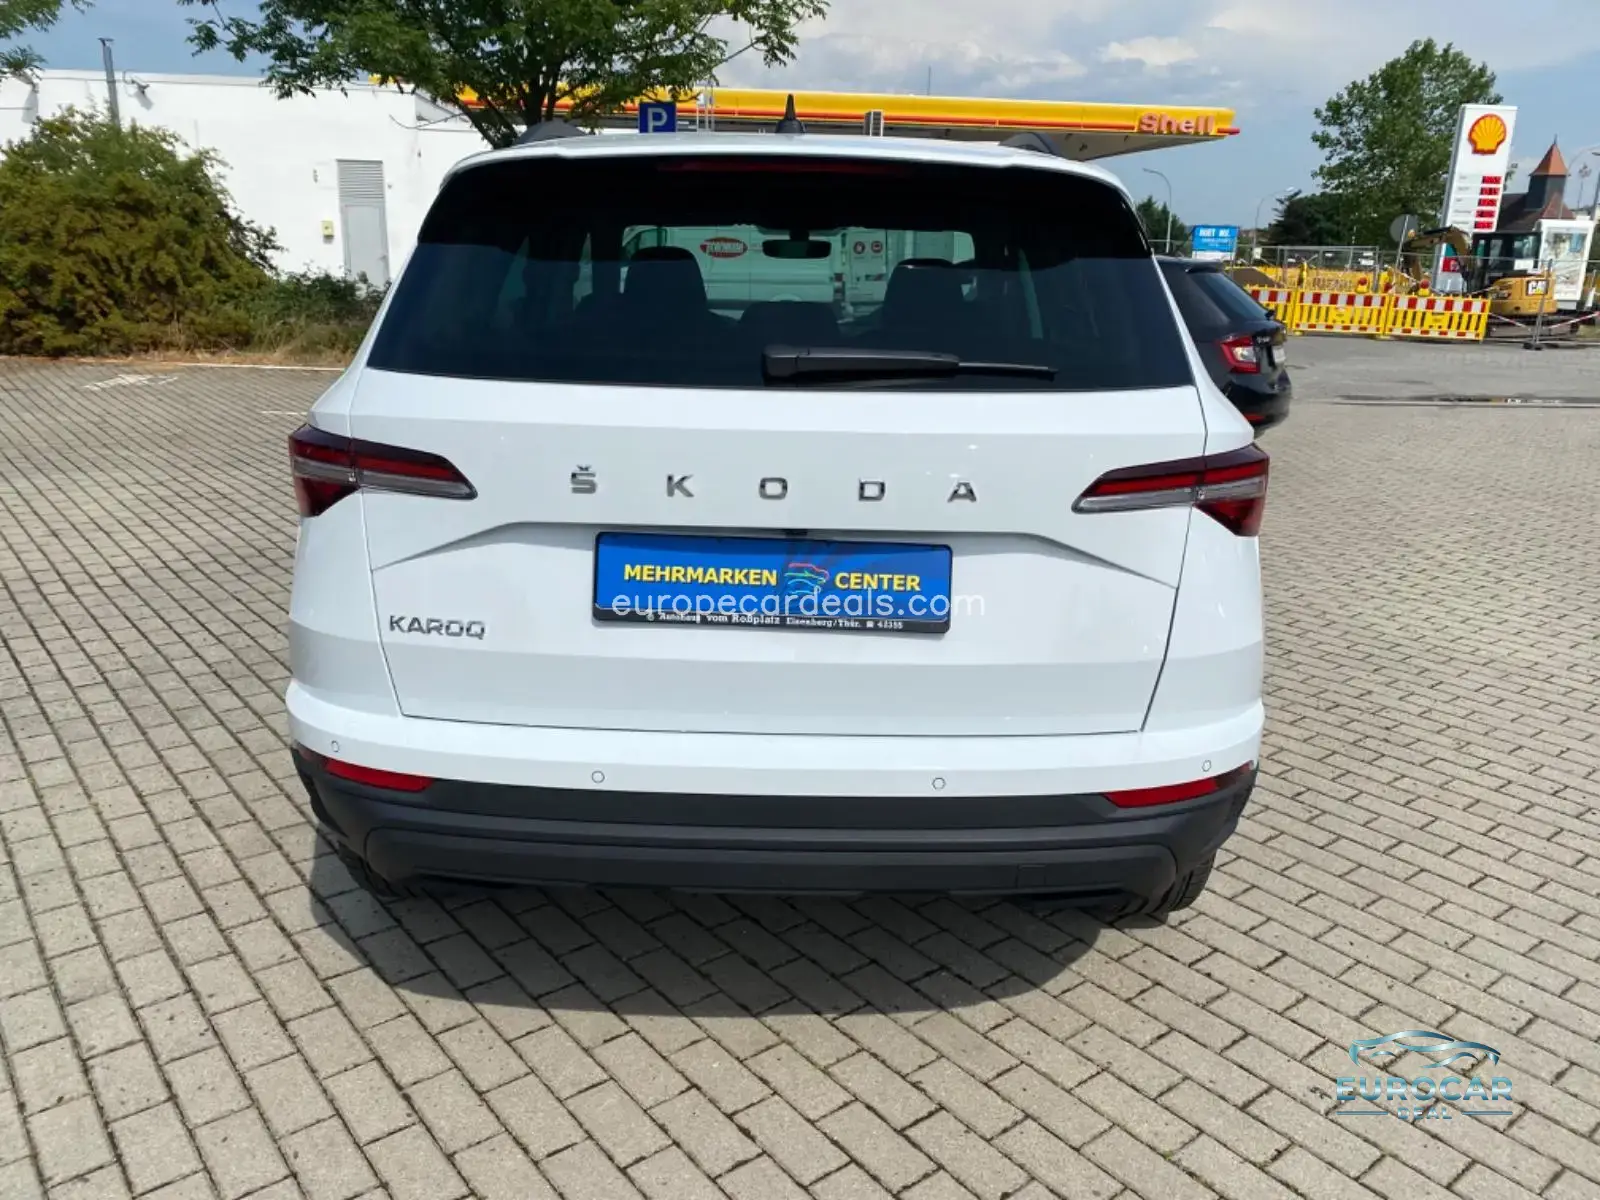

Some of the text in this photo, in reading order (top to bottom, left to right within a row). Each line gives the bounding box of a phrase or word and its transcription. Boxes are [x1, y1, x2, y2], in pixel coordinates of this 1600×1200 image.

[648, 107, 667, 133] P
[1139, 112, 1214, 135] Shell
[570, 464, 978, 504] ŠKODA
[623, 563, 922, 592] MEHRMARKEN CENTER
[389, 614, 486, 641] KAROQ
